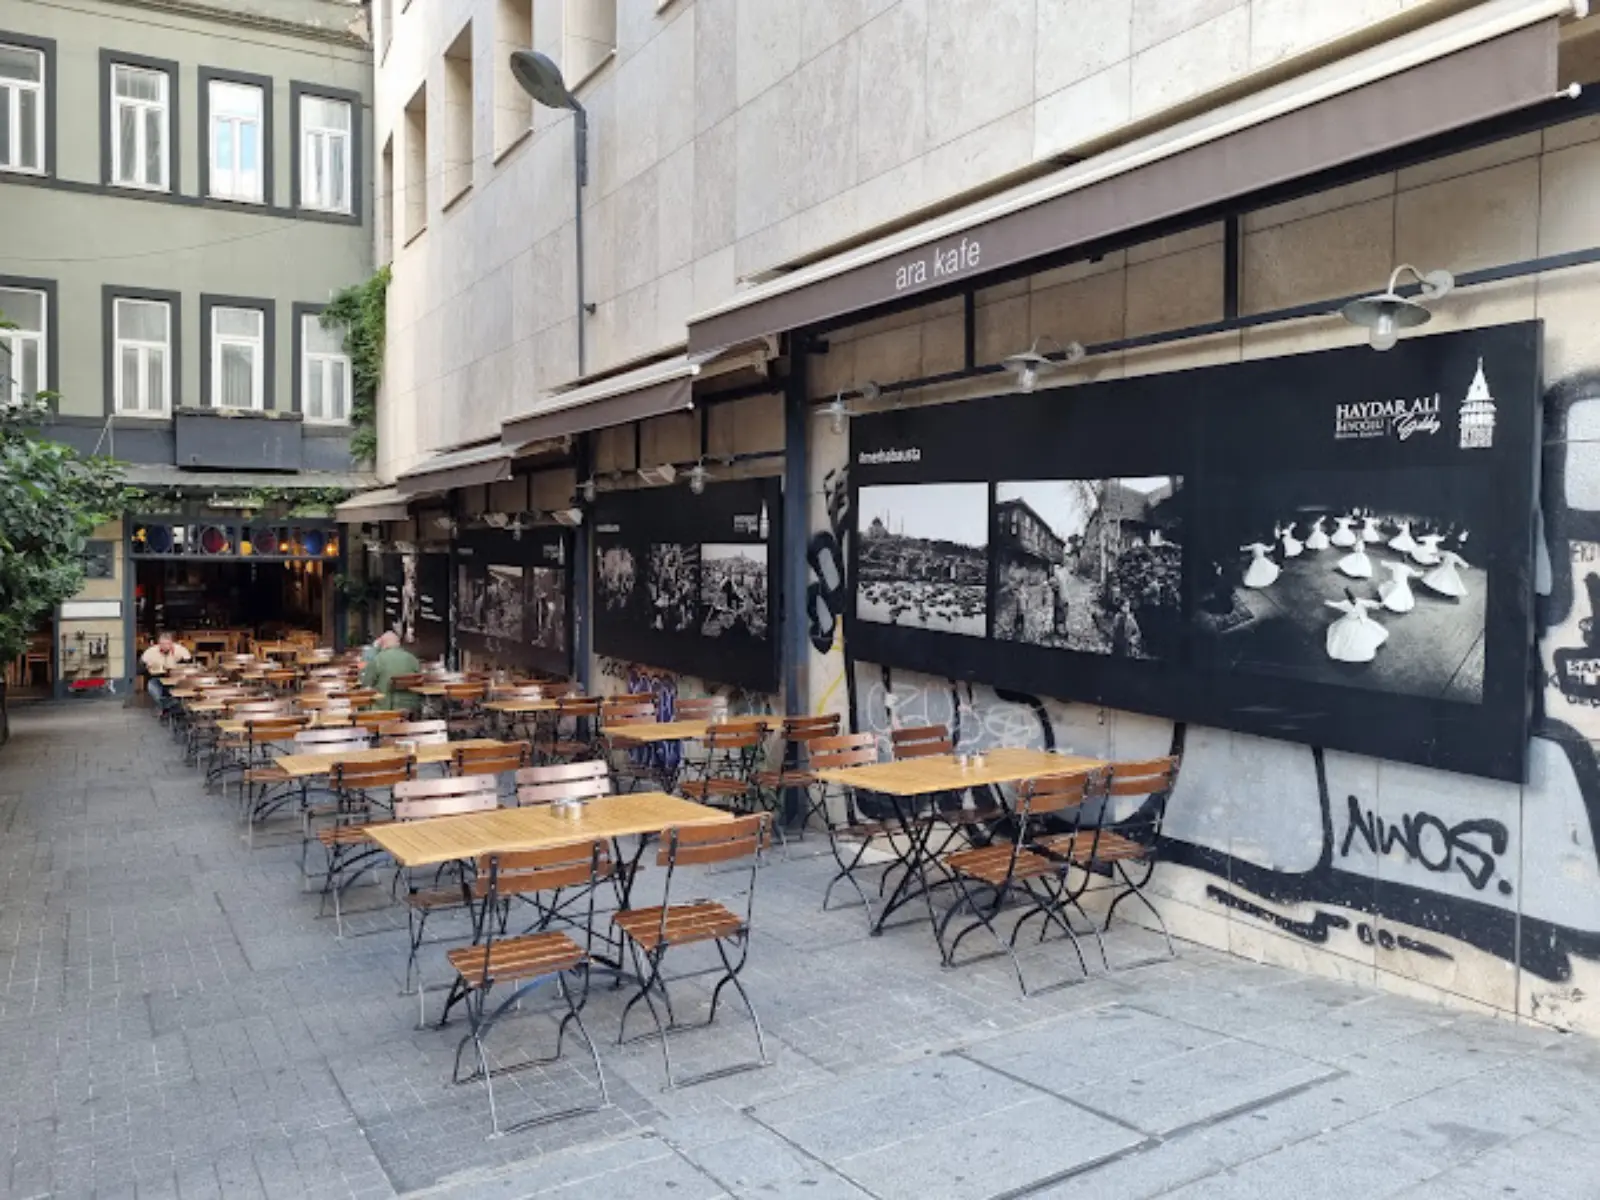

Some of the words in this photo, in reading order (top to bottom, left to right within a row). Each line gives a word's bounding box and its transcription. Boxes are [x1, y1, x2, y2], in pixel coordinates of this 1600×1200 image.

[896, 260, 927, 290] ara
[934, 237, 980, 277] kafe
[1336, 399, 1406, 419] HAYDAR
